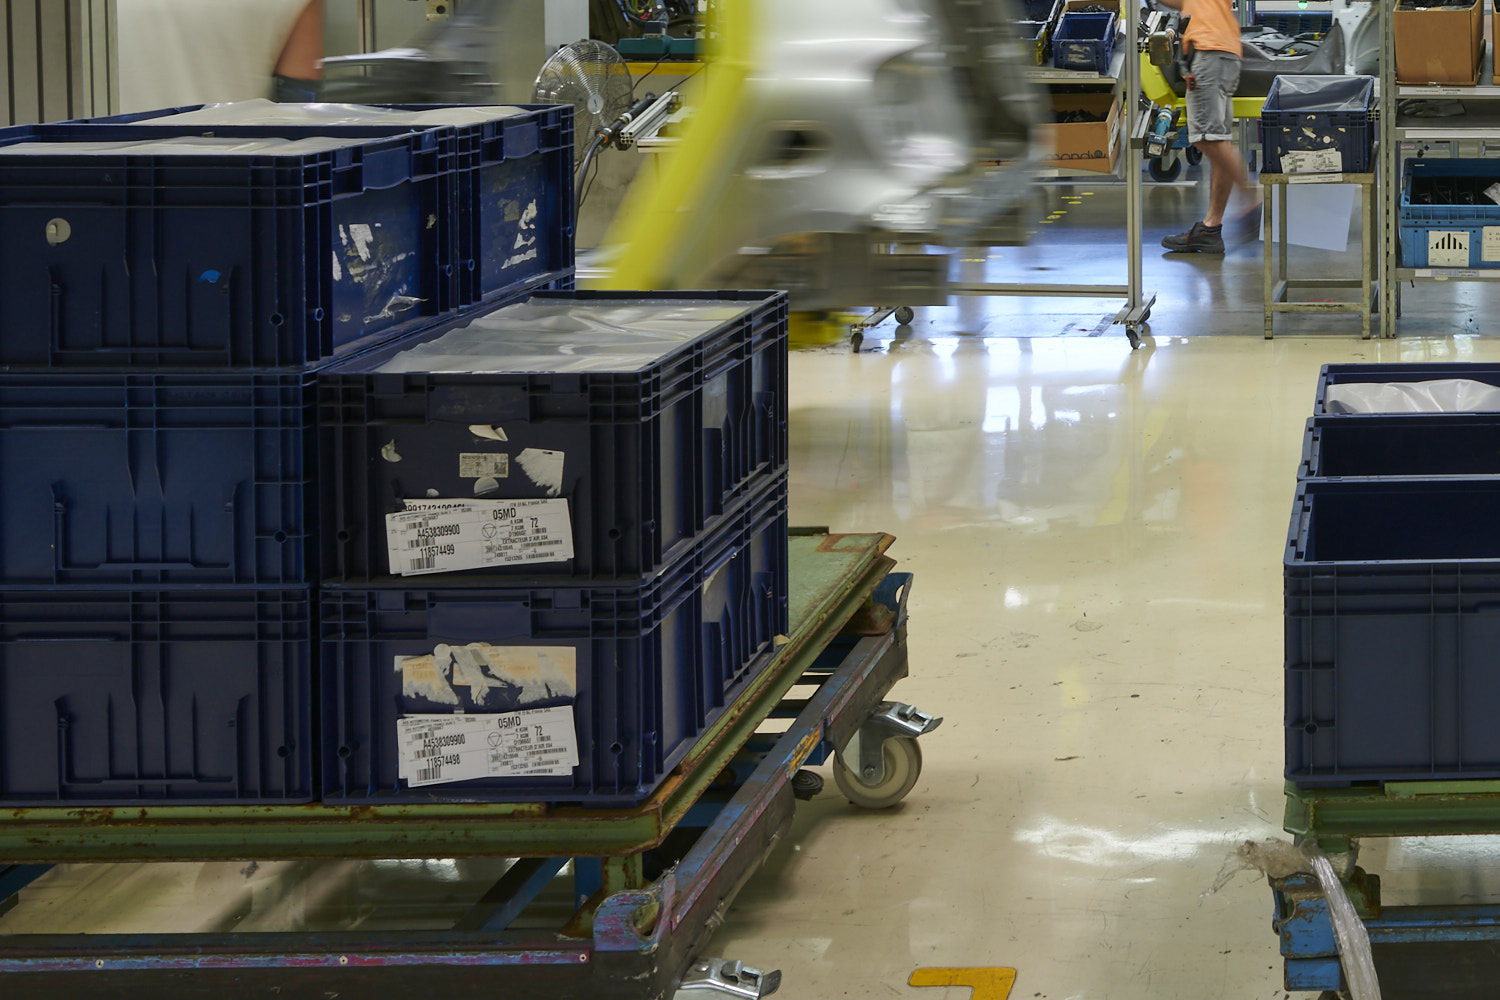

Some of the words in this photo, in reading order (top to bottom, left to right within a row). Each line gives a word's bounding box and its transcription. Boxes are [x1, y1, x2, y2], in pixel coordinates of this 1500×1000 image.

[492, 507, 517, 520] 05MD
[530, 517, 539, 529] 72
[417, 524, 460, 539] A4538309900
[420, 544, 455, 558] 118574499
[497, 716, 521, 729] 05MD
[534, 725, 543, 737] 72
[423, 734, 466, 749] A4538309900
[426, 754, 461, 768] 118574498
